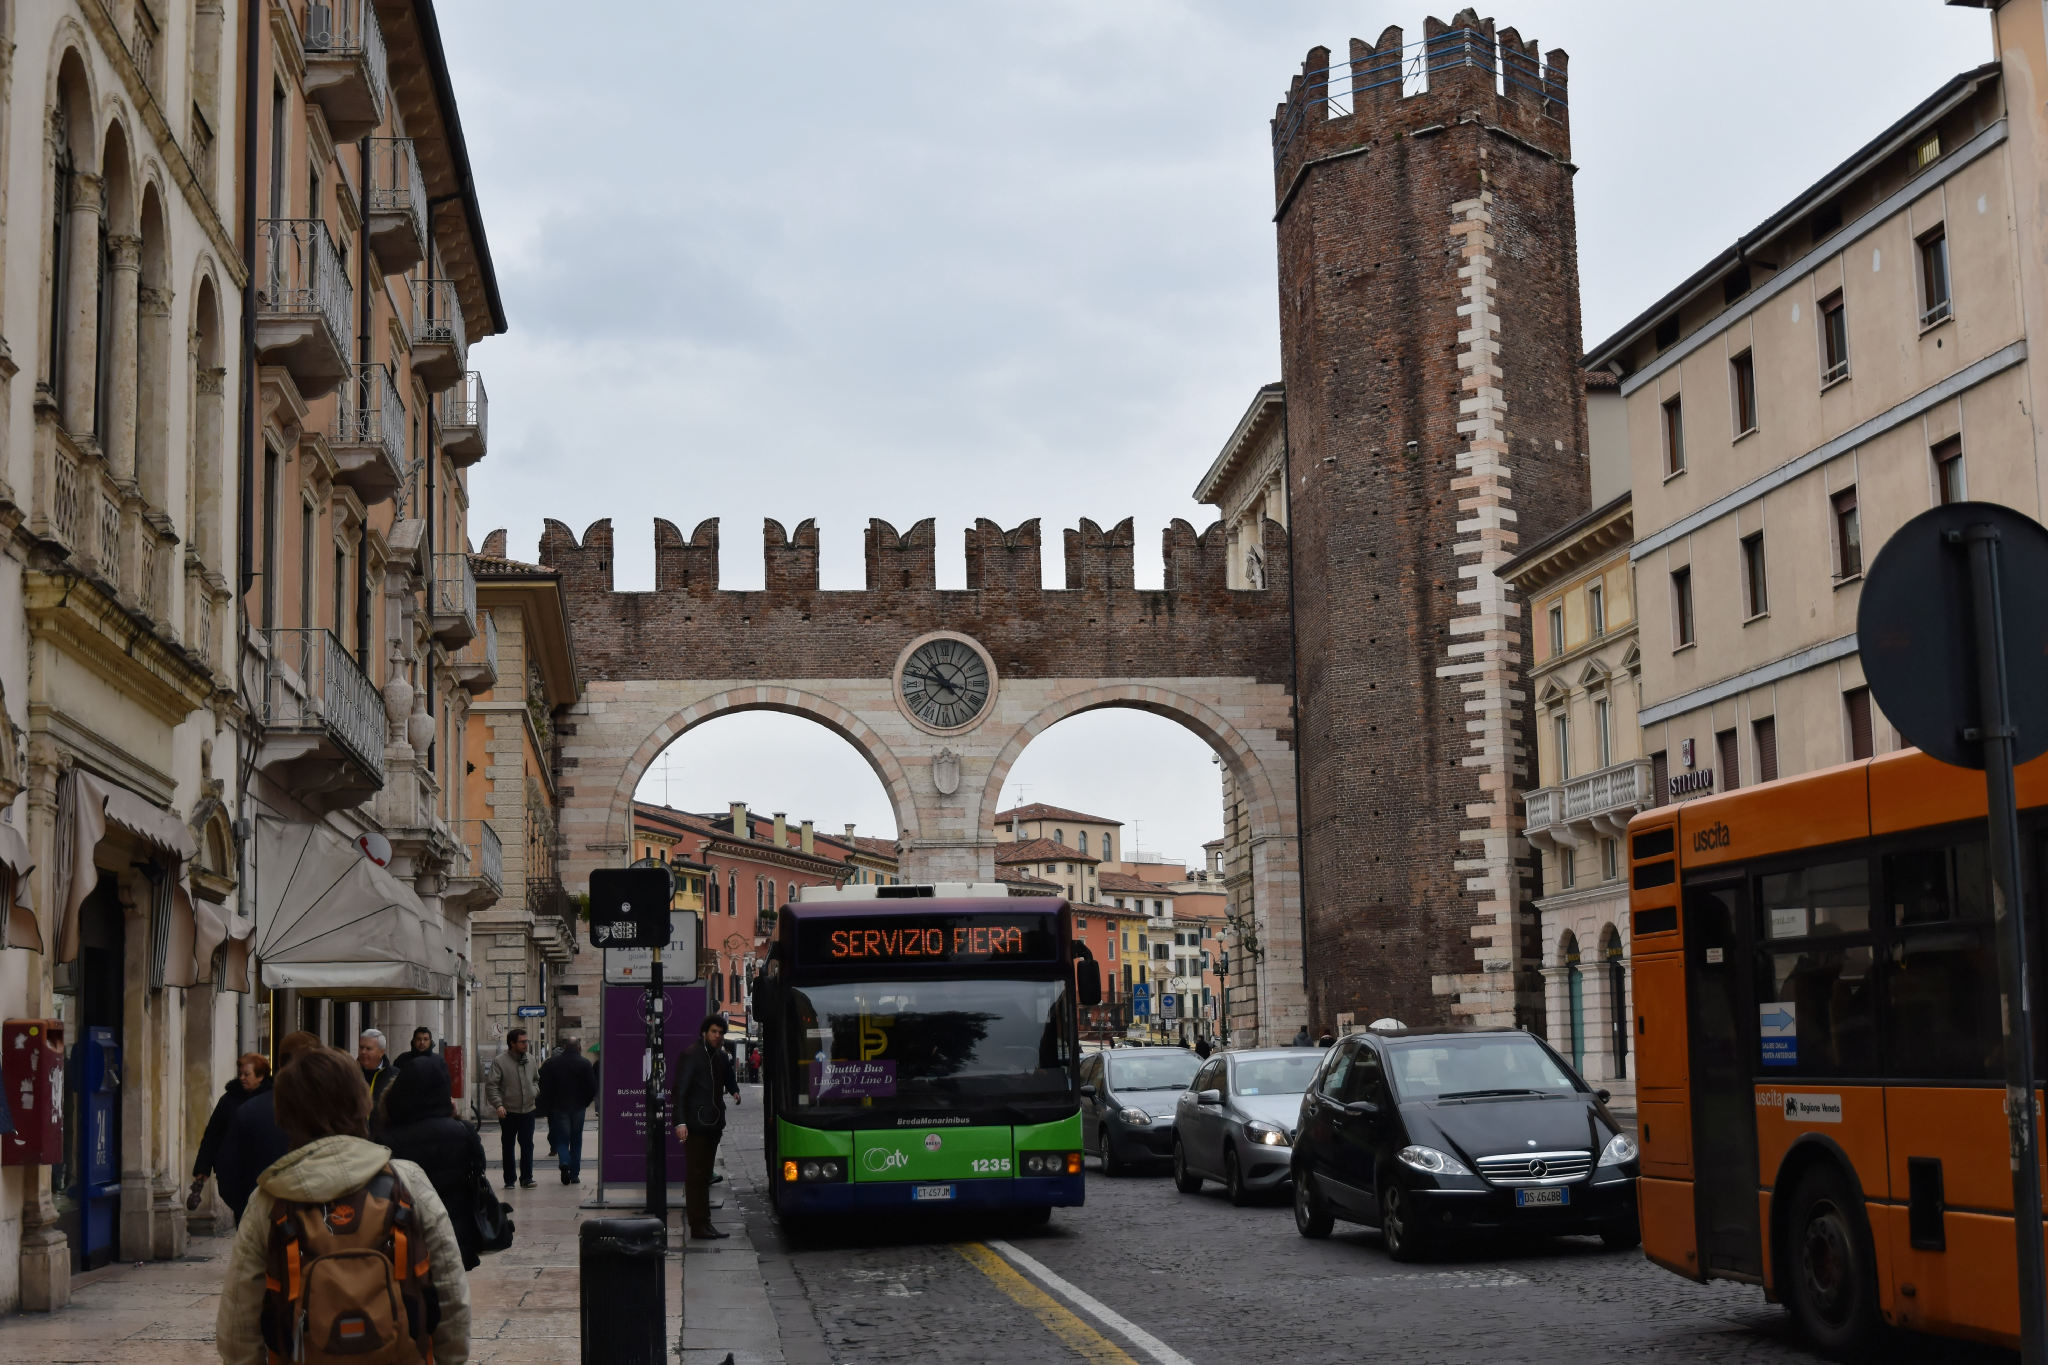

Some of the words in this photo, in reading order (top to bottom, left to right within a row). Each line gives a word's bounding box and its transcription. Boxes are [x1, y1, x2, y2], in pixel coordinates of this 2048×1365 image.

[1670, 770, 1709, 794] STITUTO
[1693, 821, 1730, 852] uscita
[832, 928, 943, 957] SERVIZIO
[953, 926, 1022, 953] FIERA
[825, 1064, 861, 1073] Shuttle
[864, 1063, 884, 1073] Bus
[843, 1076, 852, 1084] D
[860, 1075, 881, 1084] Line
[884, 1075, 892, 1083] D
[1755, 1089, 1782, 1106] uscita
[1800, 1102, 1820, 1114] Regione
[1821, 1103, 1840, 1113] Veneto
[897, 1116, 970, 1125] BredaMenarinibus
[886, 1149, 909, 1167] atv
[971, 1158, 1011, 1172] 1235
